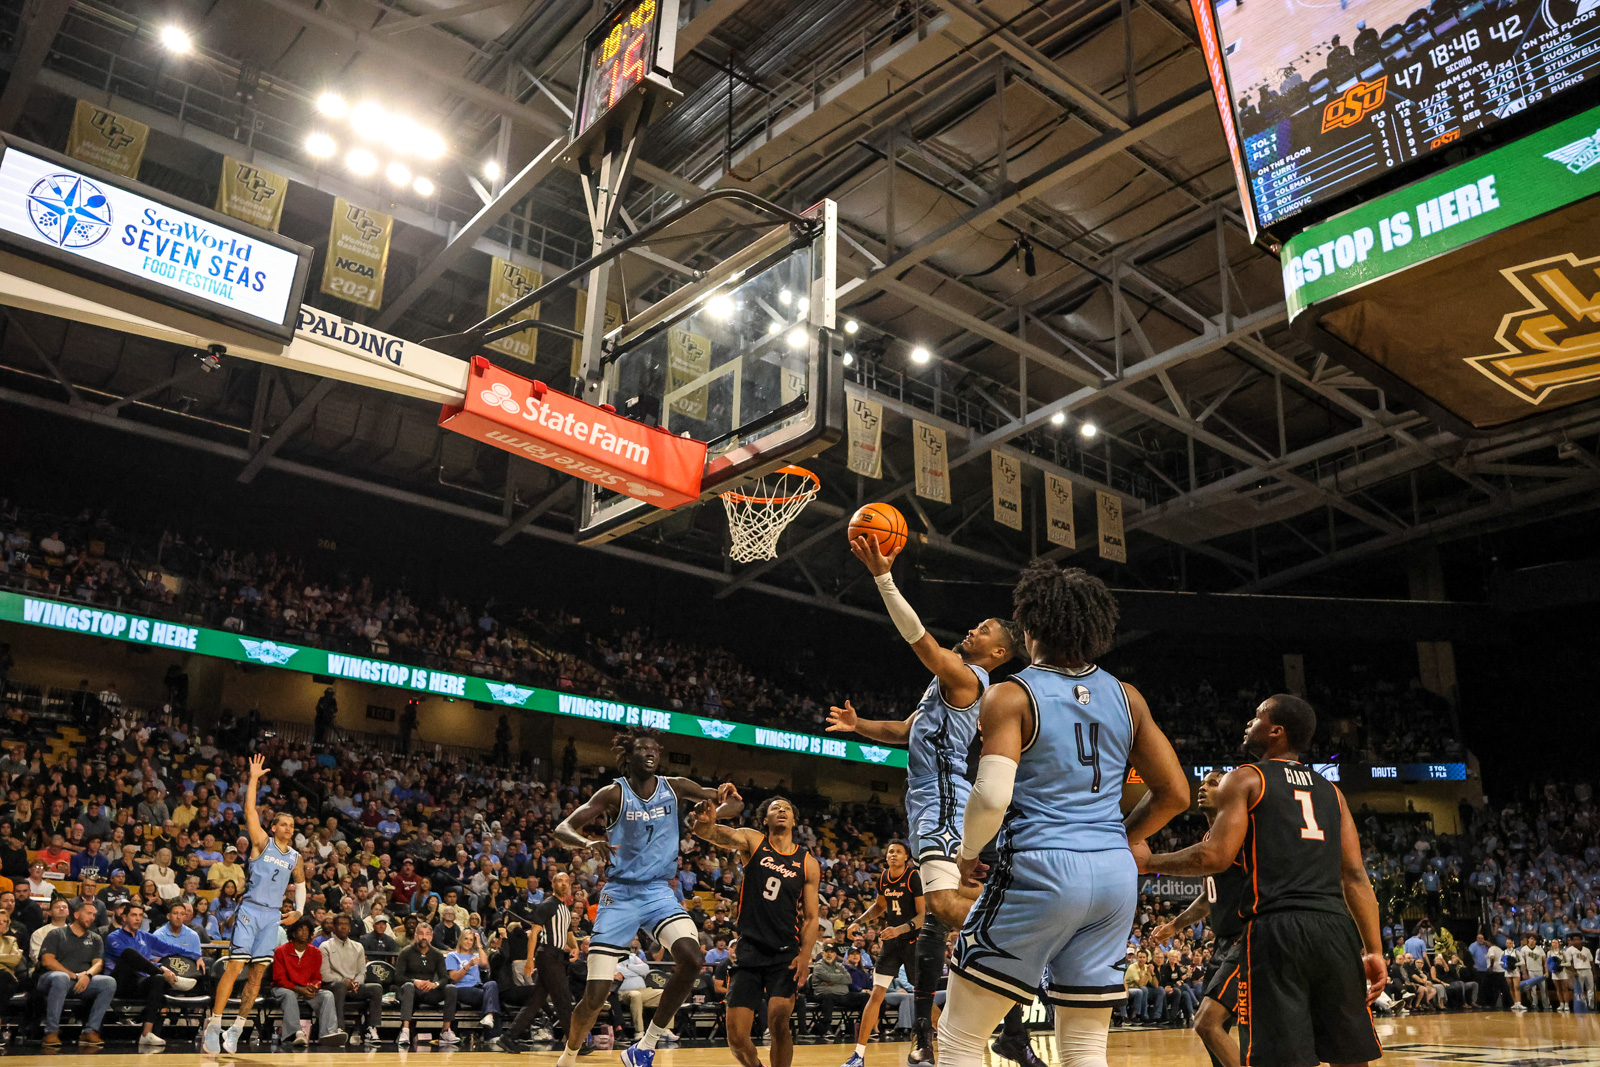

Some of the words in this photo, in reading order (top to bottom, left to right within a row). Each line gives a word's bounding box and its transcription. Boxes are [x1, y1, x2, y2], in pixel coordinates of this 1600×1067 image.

[1488, 14, 1523, 43] 42
[1521, 38, 1538, 50] ON
[1539, 28, 1560, 42] THE
[1560, 9, 1597, 32] FLOOR
[1428, 28, 1480, 68] 18:46
[1521, 52, 1528, 60] 1
[1540, 32, 1572, 52] FULKS
[1523, 62, 1532, 72] 2
[1542, 43, 1577, 63] KUGEL
[1394, 61, 1423, 90] 47
[1434, 74, 1461, 91] TEAM
[1461, 60, 1489, 79] STATS
[1445, 55, 1473, 75] SECOND
[1526, 72, 1534, 81] 4
[1544, 43, 1600, 73] STILLWELL
[1418, 90, 1448, 109] 17/35
[1458, 81, 1471, 91] FG
[1480, 59, 1512, 80] 14/34
[1424, 101, 1449, 118] 5/14
[1458, 89, 1475, 102] 3PT
[1488, 70, 1514, 88] 2/10
[1528, 91, 1543, 104] 99
[1550, 73, 1585, 94] BURKS
[1529, 82, 1536, 92] 7
[1547, 69, 1569, 84] BOL
[1321, 75, 1388, 134] OSU
[1371, 111, 1387, 123] FLS
[1394, 99, 1411, 112] PTS
[1427, 111, 1451, 127] 8/12
[1463, 100, 1475, 111] FT
[1486, 81, 1516, 100] 12/14
[1433, 124, 1446, 135] 19
[1462, 109, 1482, 122] REB
[1497, 94, 1511, 106] 23
[90, 108, 135, 149] UCF
[1251, 138, 1270, 151] TOL
[1270, 133, 1277, 142] 3
[1271, 162, 1296, 178] CURRY
[1377, 120, 1385, 128] 0
[1399, 108, 1411, 119] 12
[1253, 148, 1271, 161] FLS
[1271, 143, 1277, 152] 1
[1257, 166, 1270, 176] ON
[1270, 158, 1285, 170] THE
[1285, 146, 1312, 161] FLOOR
[1261, 195, 1268, 203] 4
[1274, 176, 1312, 197] COLEMAN
[1382, 139, 1390, 148] 2
[1405, 128, 1413, 137] 5
[1273, 172, 1298, 188] CLARY
[1380, 129, 1386, 138] 1
[1404, 118, 1411, 127] 8
[236, 163, 275, 202] UCF
[1262, 212, 1273, 223] 19
[1278, 196, 1313, 216] VUKOVIC
[1386, 158, 1394, 167] 0
[1410, 147, 1418, 157] 3
[1263, 204, 1269, 212] 9
[1276, 194, 1293, 206] ROY
[1385, 149, 1391, 157] 1
[1408, 138, 1416, 147] 9
[346, 203, 382, 242] UCF
[1263, 208, 1302, 229] DAKTRONICS
[1378, 210, 1413, 253] IS
[1415, 174, 1500, 238] HERE
[142, 207, 253, 263] SeaWorld
[337, 239, 381, 260] Basketball
[341, 232, 380, 252] Women's
[122, 224, 202, 270] SEVEN
[208, 254, 267, 293] SEAS
[336, 256, 376, 280] NCAA
[142, 256, 176, 280] FOOD
[178, 268, 235, 301] FESTIVAL
[330, 276, 377, 303] 2021
[295, 308, 404, 367] PALDING
[853, 398, 878, 429] UCF
[920, 425, 942, 456] UCF
[997, 455, 1017, 484] UCF
[998, 497, 1018, 512] NCAA
[1049, 476, 1069, 505] UCF
[1051, 518, 1071, 533] NCAA
[1103, 534, 1122, 547] NCAA
[23, 598, 127, 637] WINGSTOP
[128, 617, 150, 641] IS
[151, 621, 199, 650] HERE
[327, 653, 410, 686] WINGSTOP
[410, 668, 427, 689] IS
[429, 672, 467, 696] HERE
[558, 694, 625, 724] WINGSTOP
[626, 706, 640, 725] IS
[642, 709, 672, 731] HERE
[755, 727, 810, 752] WINGSTOP
[810, 736, 821, 754] IS
[822, 739, 847, 758] HERE
[1074, 722, 1102, 793] 4
[1284, 767, 1314, 786] CLARY
[1371, 766, 1398, 778] NAUTS
[1294, 789, 1325, 841] 1
[645, 824, 654, 845] 7
[271, 868, 280, 882] 2
[759, 856, 798, 879] Cowboys
[762, 876, 782, 901] 9
[884, 888, 904, 898] Cowboys
[1140, 879, 1204, 896] Addition
[891, 900, 902, 916] 4
[168, 957, 191, 975] UCF
[371, 965, 390, 981] UCF
[1238, 981, 1249, 1025] POKES
